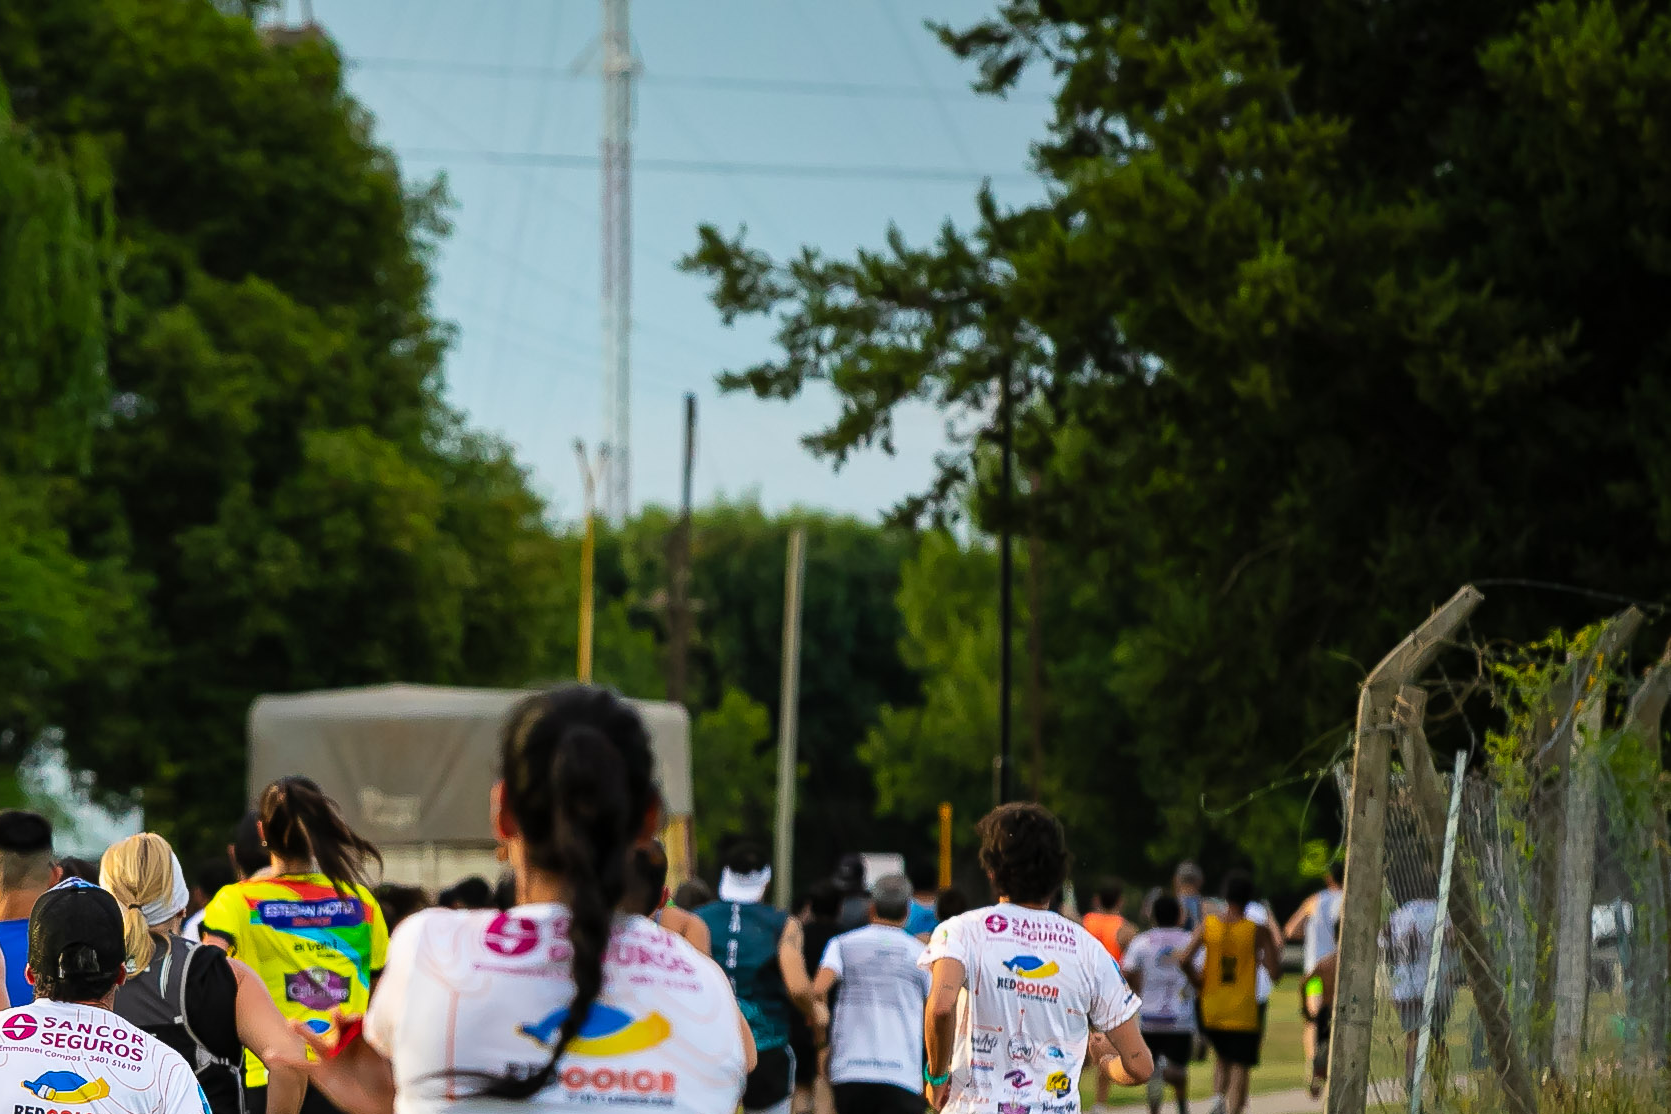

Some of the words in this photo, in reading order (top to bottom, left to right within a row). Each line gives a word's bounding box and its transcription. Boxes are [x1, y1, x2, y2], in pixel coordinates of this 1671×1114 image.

[1012, 928, 1076, 946] SEGUROS
[43, 1016, 145, 1047] SANCOR
[40, 1032, 144, 1062] SEGUROS
[89, 1055, 109, 1064] 3401
[112, 1059, 142, 1073] 516109
